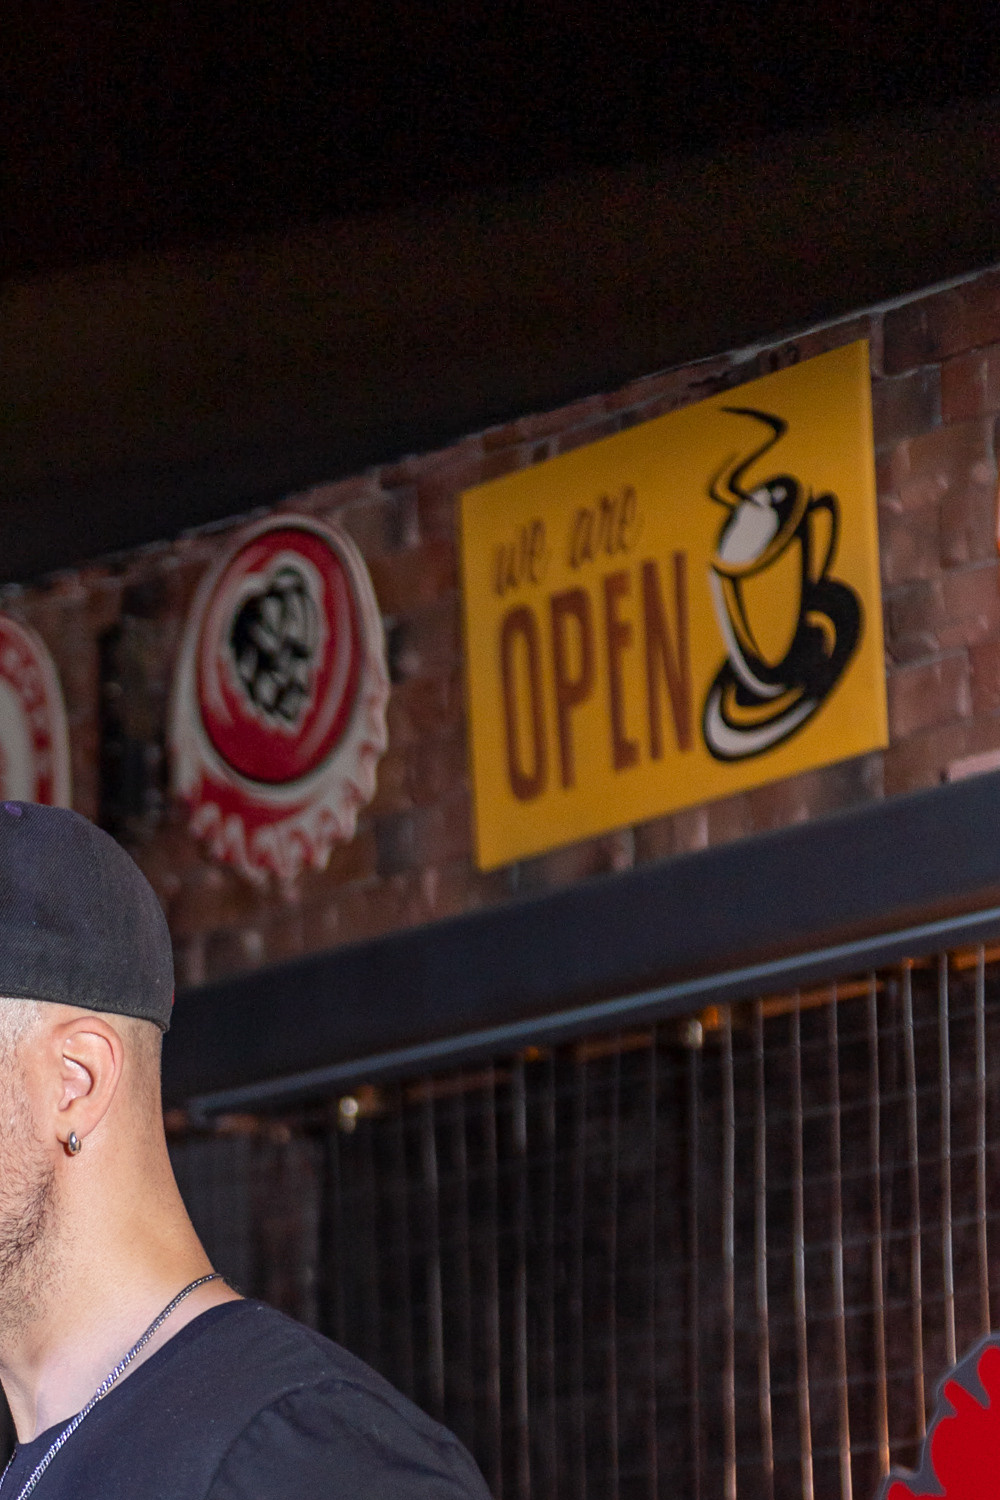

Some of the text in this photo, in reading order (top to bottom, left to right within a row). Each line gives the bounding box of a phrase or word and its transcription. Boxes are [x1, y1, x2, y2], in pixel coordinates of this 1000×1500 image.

[493, 484, 639, 596] we are
[500, 550, 695, 803] OPEN
